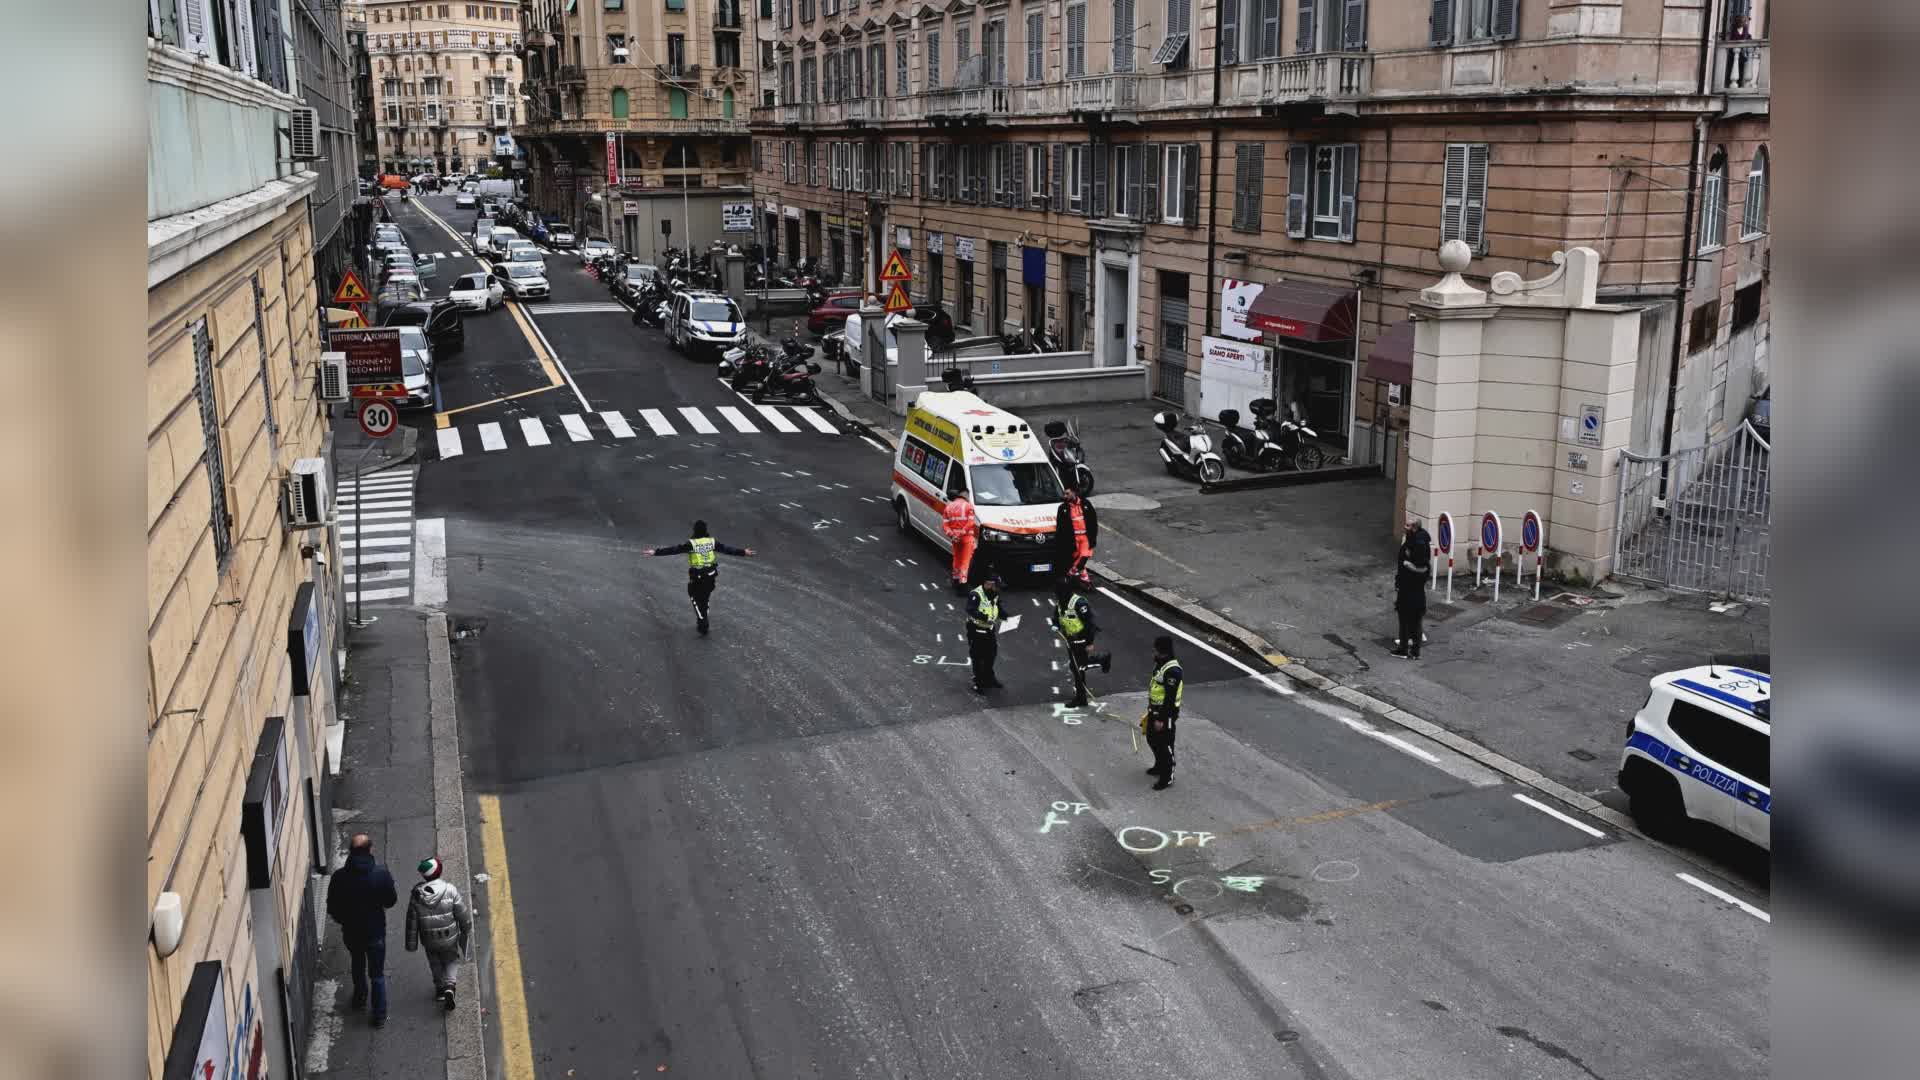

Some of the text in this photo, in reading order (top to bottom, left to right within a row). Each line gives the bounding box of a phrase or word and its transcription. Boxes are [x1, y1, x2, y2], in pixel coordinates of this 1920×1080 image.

[1209, 348, 1226, 358] SIAMO
[1226, 352, 1245, 361] APERTI
[367, 408, 389, 427] 30
[1692, 764, 1737, 793] POLIZIA
